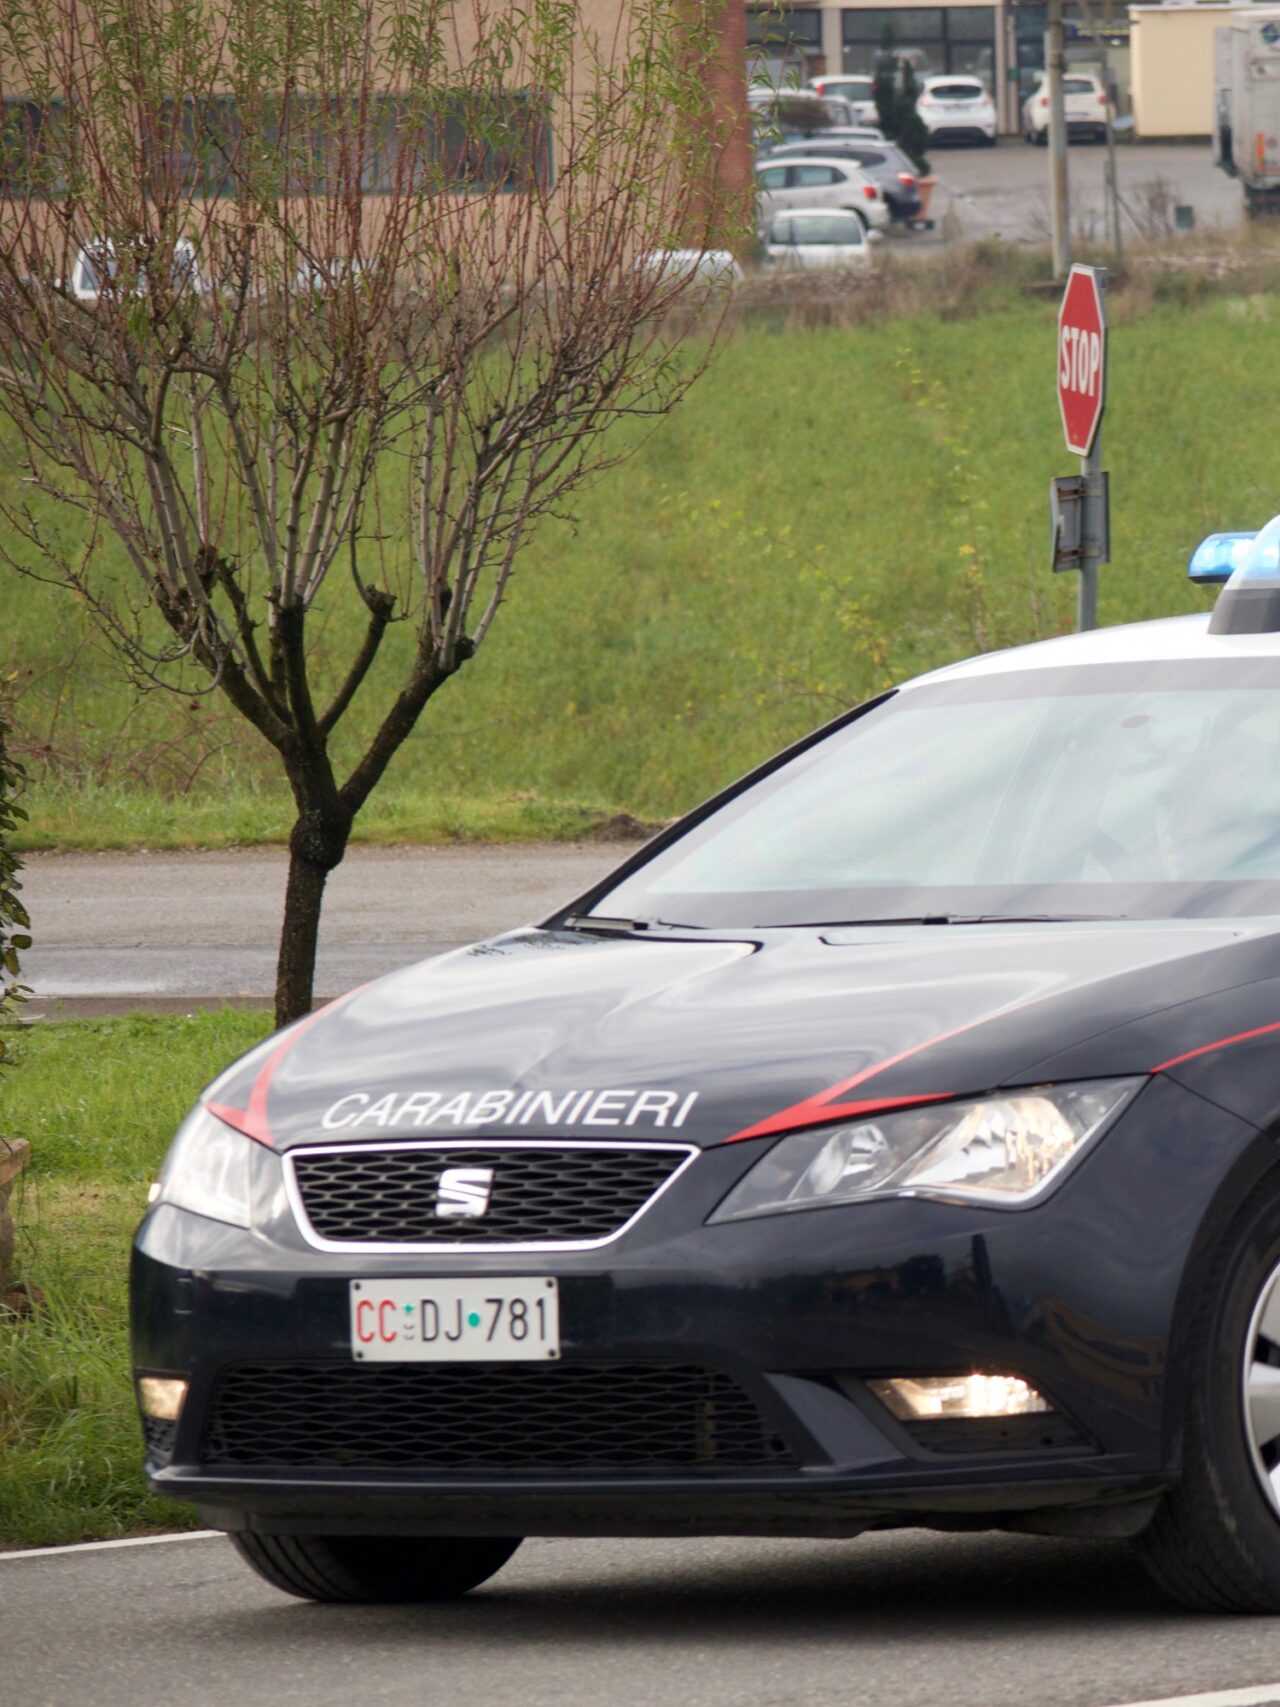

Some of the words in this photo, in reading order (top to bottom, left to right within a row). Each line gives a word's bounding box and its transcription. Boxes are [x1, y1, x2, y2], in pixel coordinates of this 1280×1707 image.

[1061, 325, 1100, 397] STOP
[321, 1090, 698, 1129] CARABINIERI
[357, 1300, 397, 1343] CC
[420, 1299, 462, 1342] DJ
[485, 1298, 546, 1342] 781
